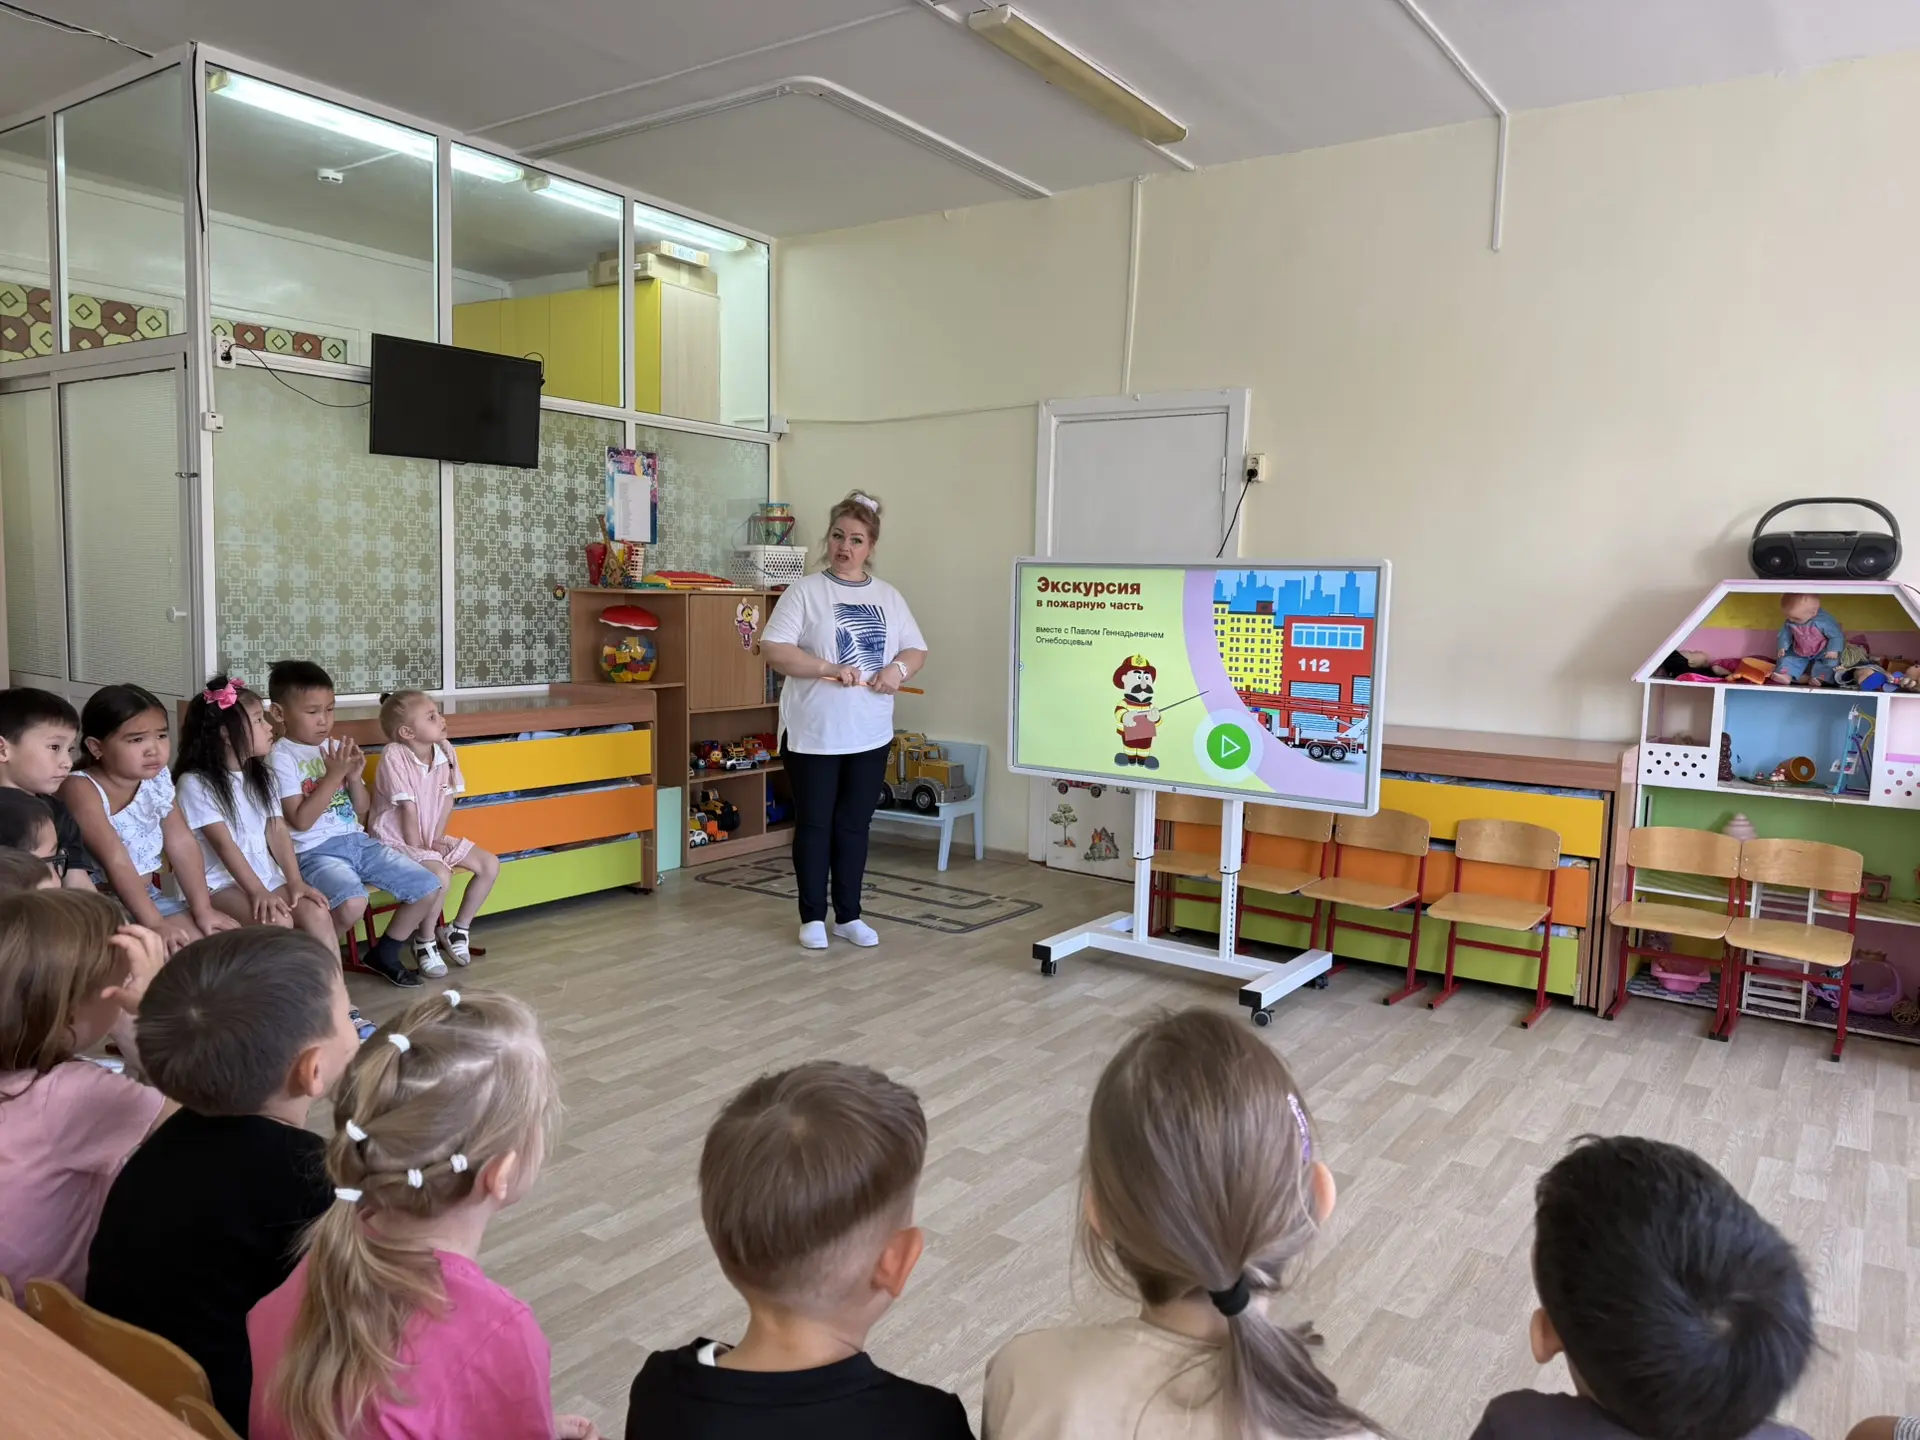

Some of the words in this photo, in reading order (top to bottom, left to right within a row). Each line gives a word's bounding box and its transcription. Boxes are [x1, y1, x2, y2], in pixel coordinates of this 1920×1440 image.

[1037, 576, 1141, 597] Экскурсия
[1036, 599, 1043, 607] в
[1046, 600, 1106, 611] пожарную
[1109, 601, 1144, 611] часть
[1035, 626, 1062, 634] вместе
[1070, 627, 1100, 636] Павлом
[1102, 628, 1164, 638] Геннадьевичем
[1036, 636, 1093, 646] Огнеборцевым
[1298, 658, 1330, 673] 112
